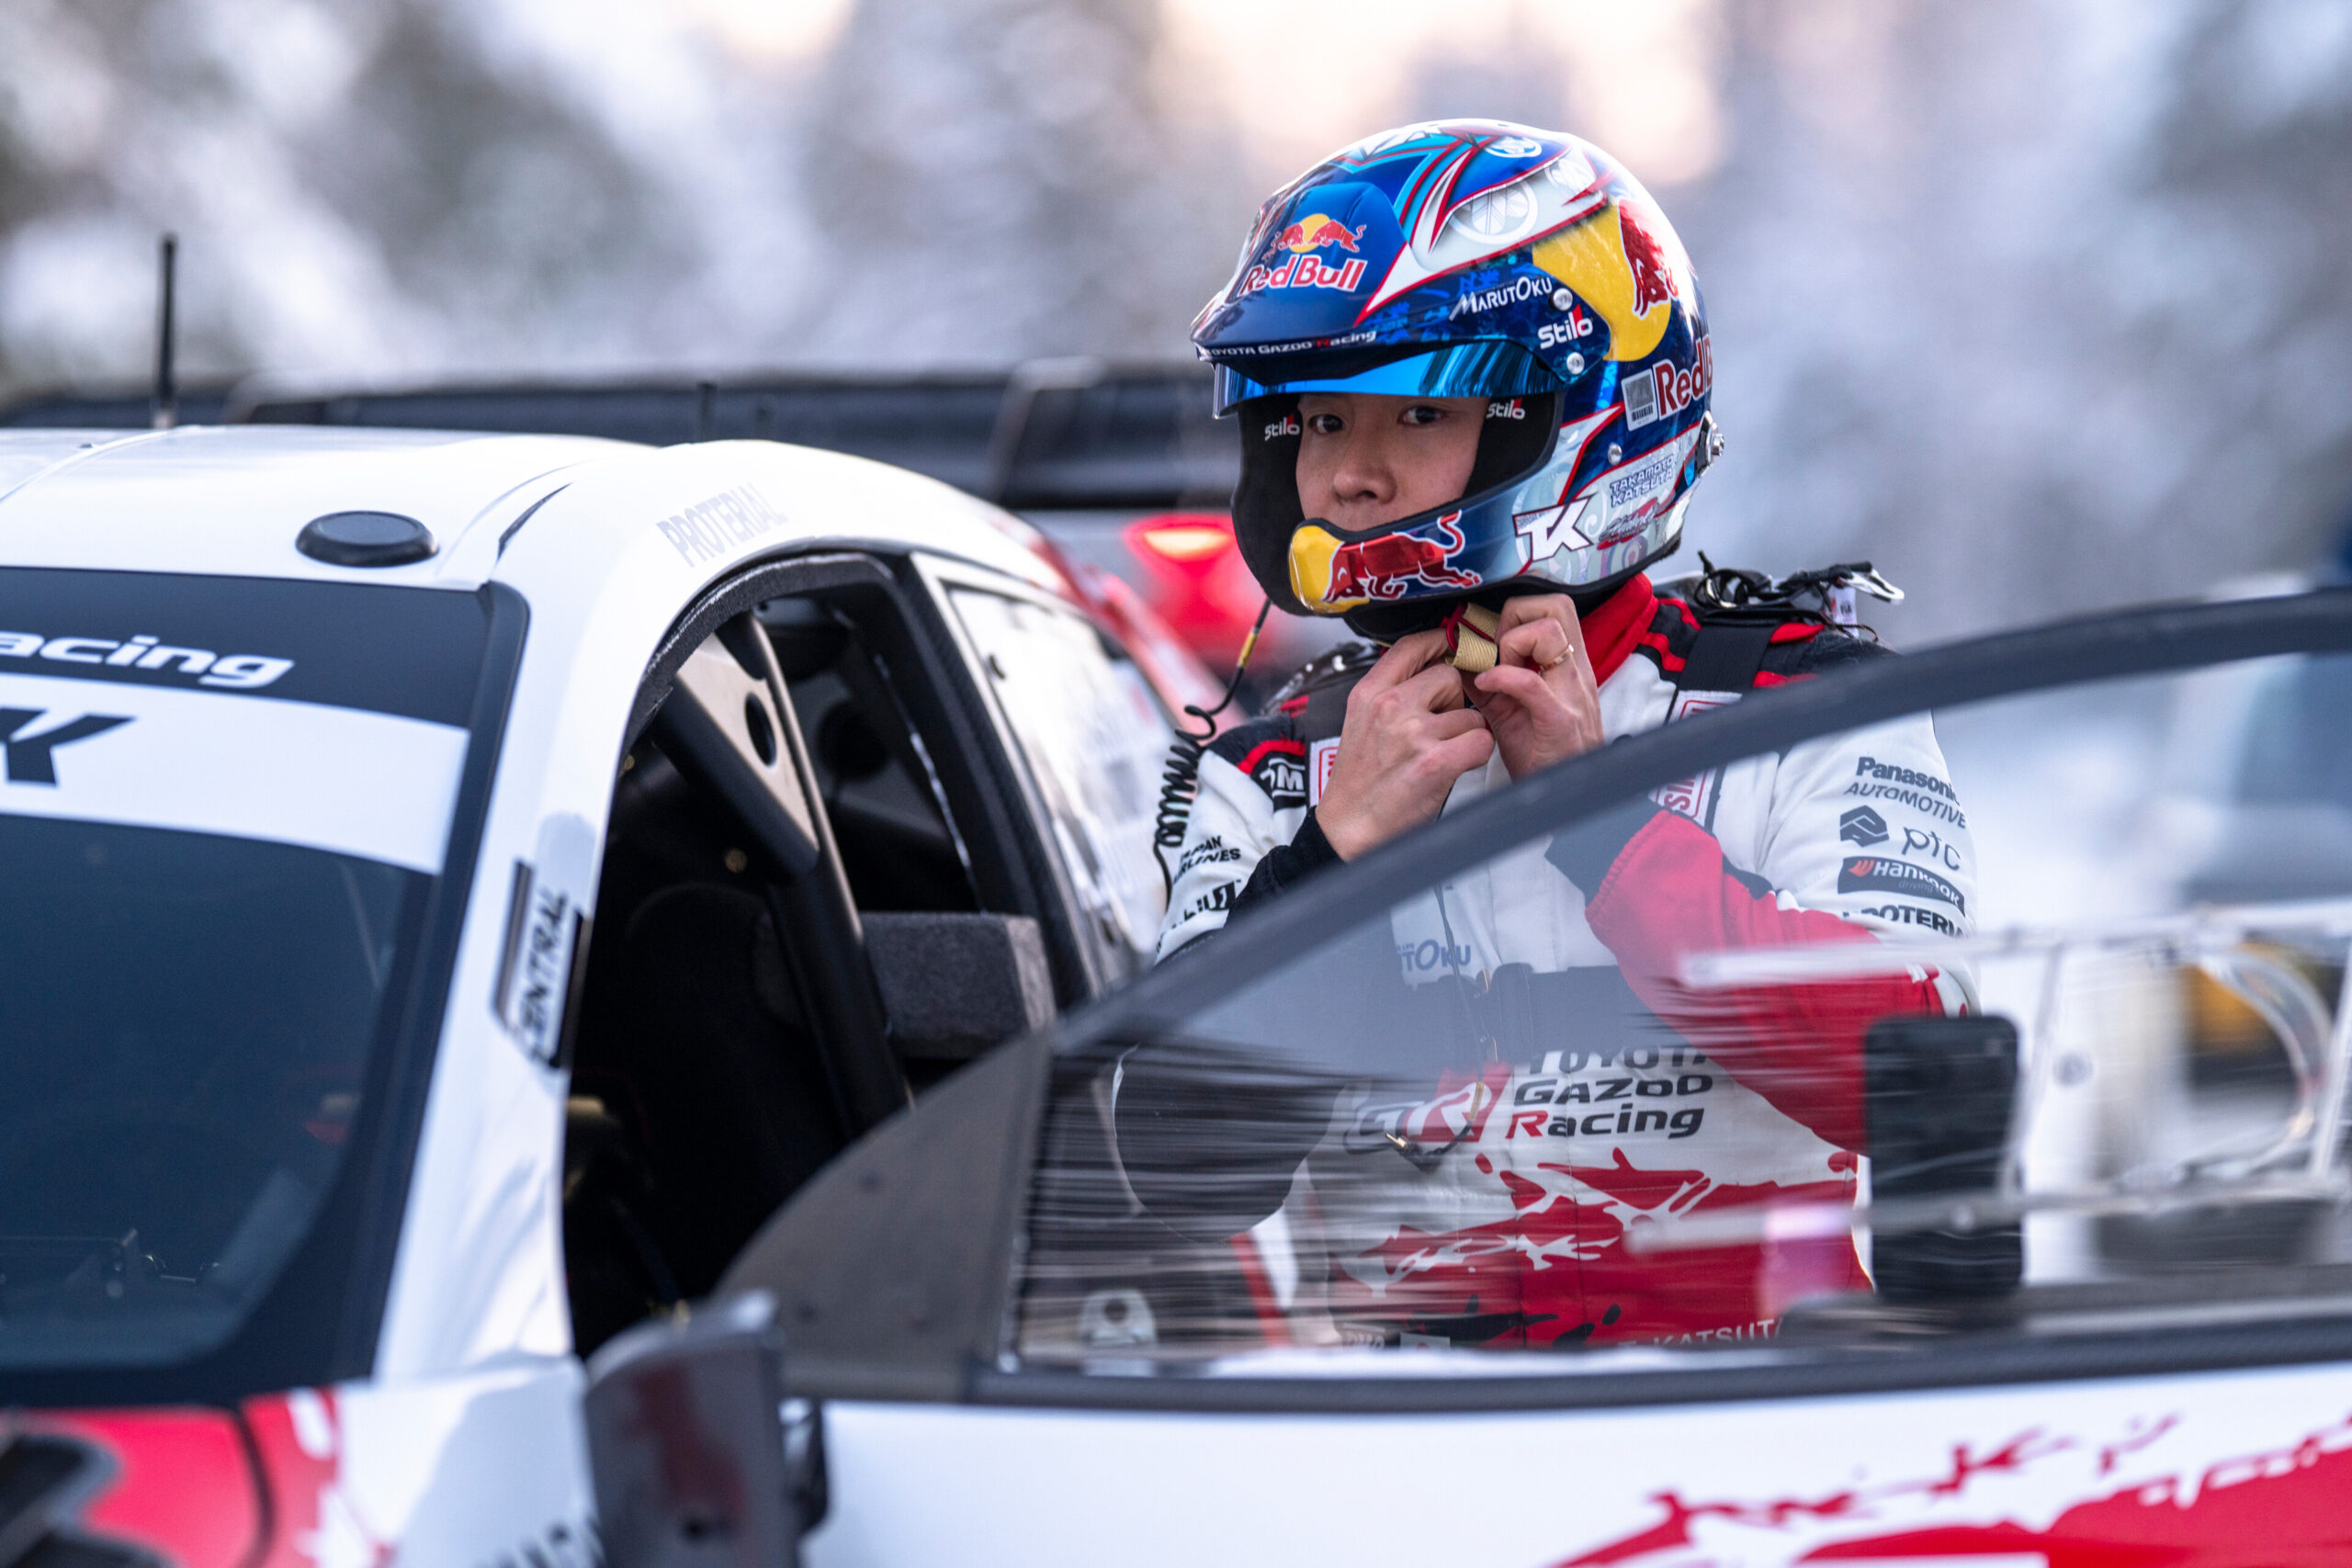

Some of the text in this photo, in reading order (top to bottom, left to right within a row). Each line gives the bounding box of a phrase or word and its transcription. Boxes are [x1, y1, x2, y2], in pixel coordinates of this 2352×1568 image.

[1238, 254, 1368, 297] Red Bull
[1315, 330, 1377, 348] Racing
[1653, 338, 1705, 421] Red
[1610, 454, 1675, 493] TAKAMOTO
[1611, 468, 1673, 508] KATSUTA
[1512, 494, 1594, 563] TK
[1843, 782, 1966, 829] AUTOMOTIVE
[1901, 827, 1962, 872] ptc
[1505, 1102, 1704, 1139] Racing
